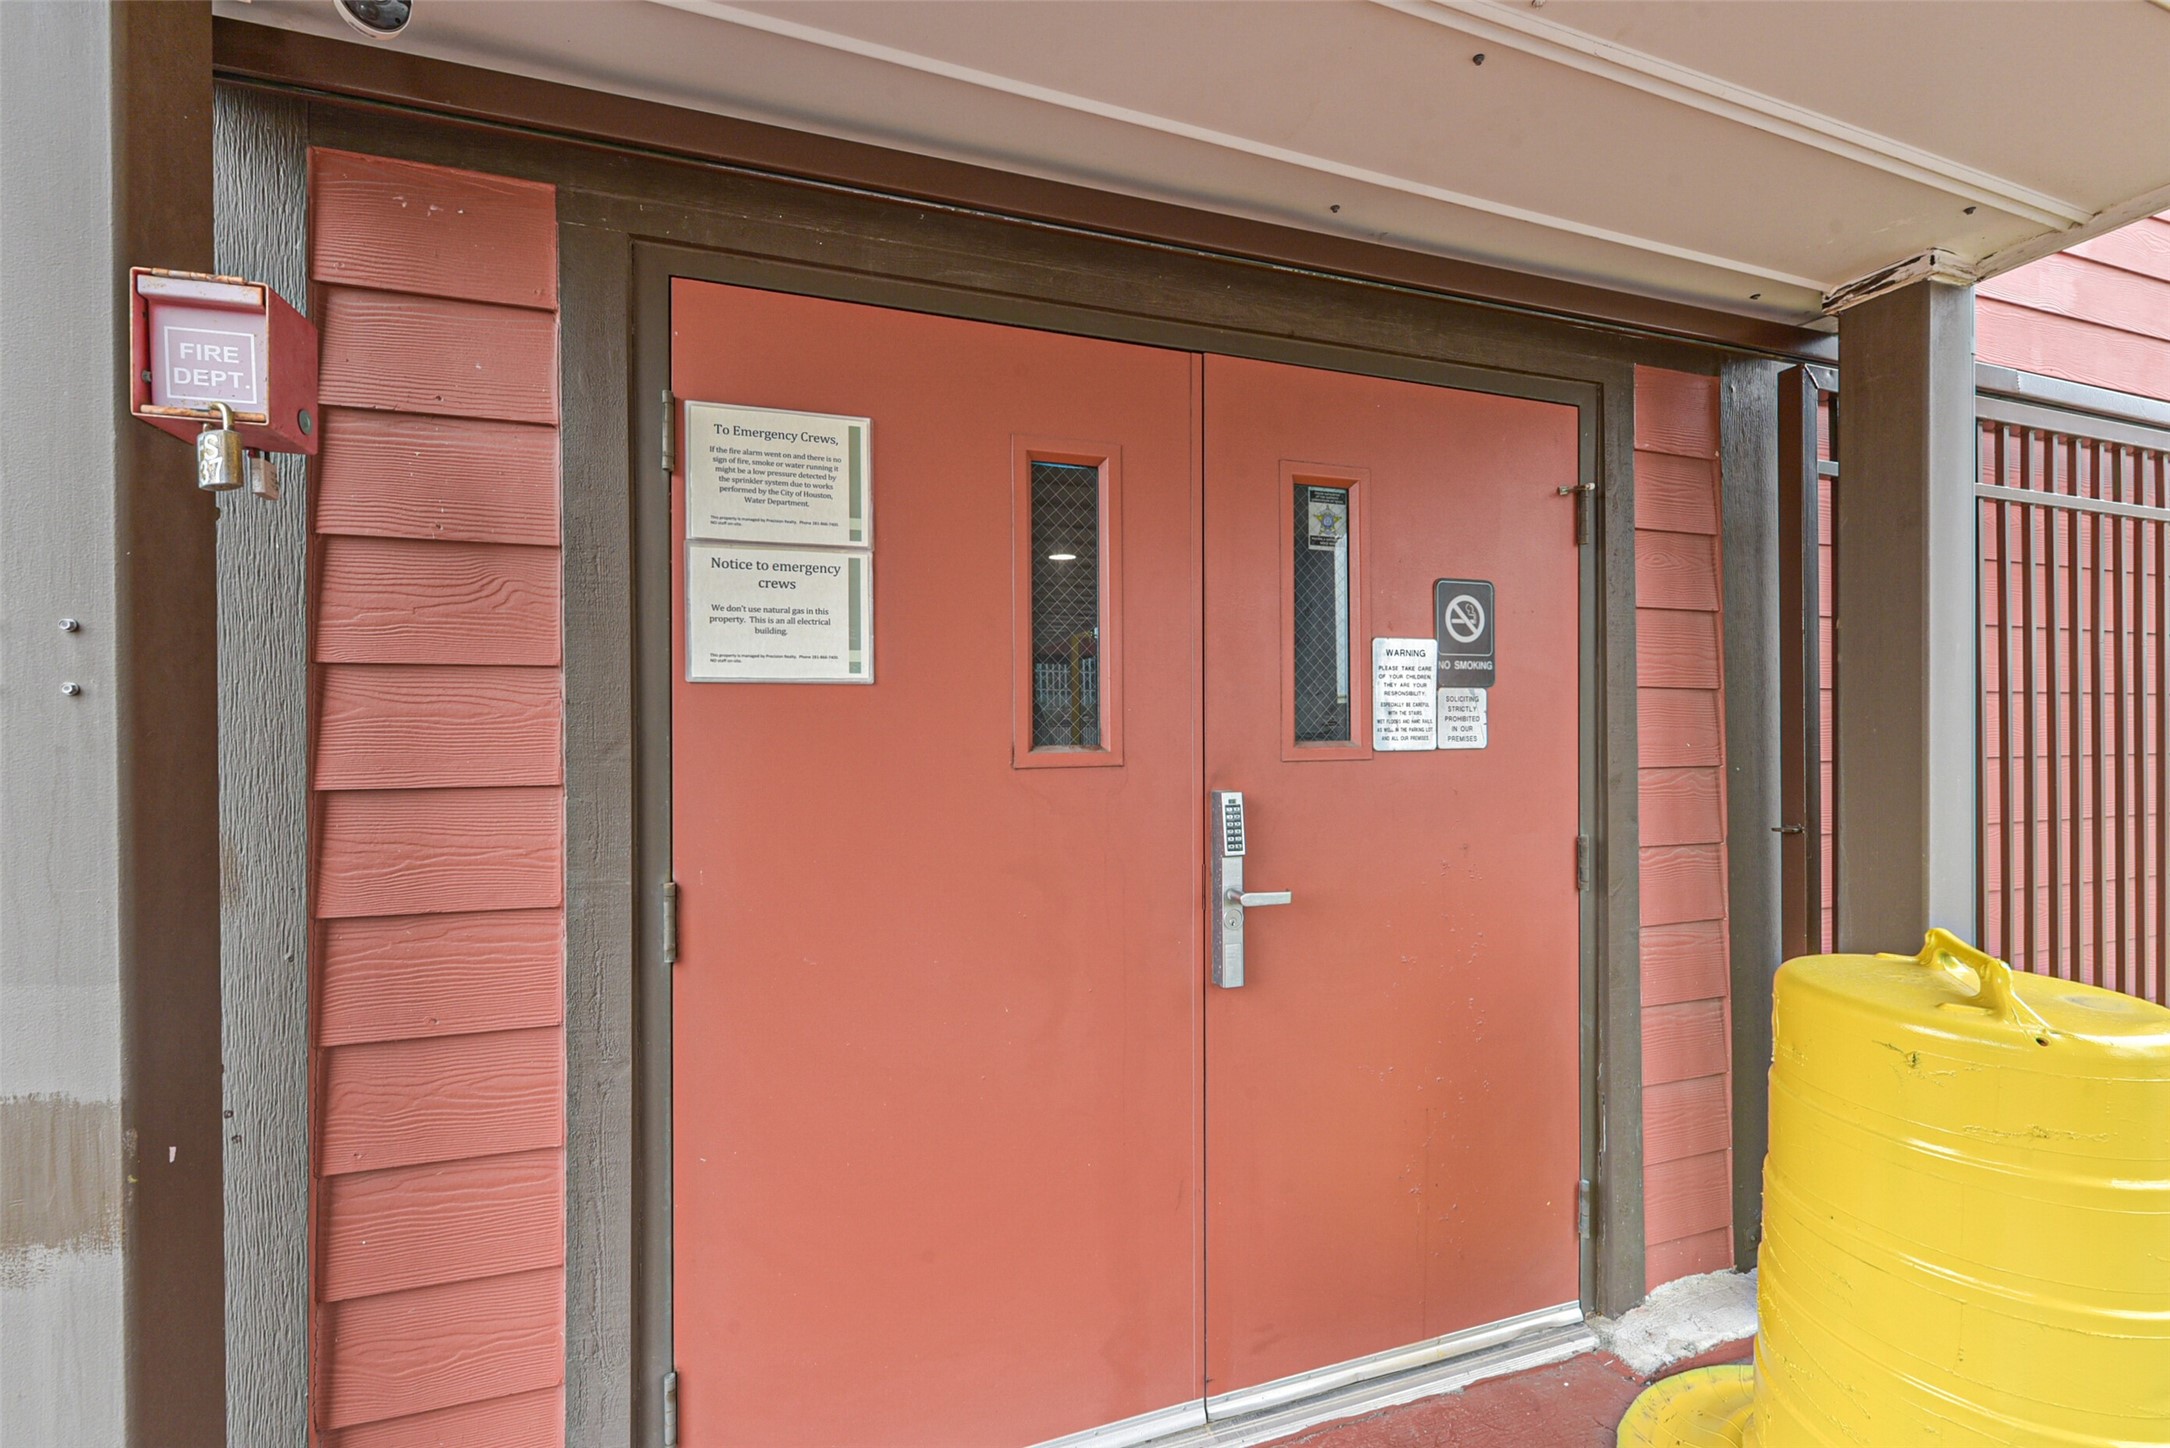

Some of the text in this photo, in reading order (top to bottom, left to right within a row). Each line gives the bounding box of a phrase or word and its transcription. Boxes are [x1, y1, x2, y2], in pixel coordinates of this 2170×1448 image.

[179, 342, 240, 364] FIRE
[173, 367, 251, 389] DEPT.
[713, 423, 839, 446] To Emergency Crews,
[709, 445, 715, 453] If
[715, 446, 728, 454] the
[728, 447, 741, 455] fire
[806, 454, 825, 462] there
[200, 457, 223, 484] 37
[712, 456, 728, 464] sign
[736, 457, 751, 466] fire,
[805, 464, 833, 473] running
[715, 466, 736, 474] might
[736, 466, 746, 474] be
[766, 470, 797, 478] pressure
[797, 471, 827, 480] detected
[827, 474, 837, 482] by
[718, 474, 731, 482] the
[731, 477, 764, 485] sprinkler
[764, 479, 790, 487] system
[789, 480, 804, 488] due
[719, 485, 757, 494] performed
[757, 487, 767, 496] by
[780, 489, 795, 498] City
[803, 490, 834, 500] Houston,
[744, 496, 810, 507] Water Department.
[711, 557, 841, 577] Notice to emergency
[758, 579, 796, 590] crews
[711, 603, 725, 611] We
[725, 604, 747, 612] don't
[762, 606, 791, 614] natural
[791, 608, 805, 616] gas
[805, 607, 814, 615] in
[814, 607, 829, 616] this
[709, 616, 747, 625] property.
[749, 616, 767, 624] This
[767, 616, 774, 624] is
[786, 616, 796, 625] all
[796, 617, 831, 626] electrical
[754, 626, 788, 637] building.
[1385, 649, 1426, 657] WARNING
[1438, 660, 1493, 671] NO SMOKING
[1445, 695, 1480, 703] SOLICITING
[1447, 705, 1477, 713] STRICTLY
[1447, 735, 1478, 743] PREMISES
